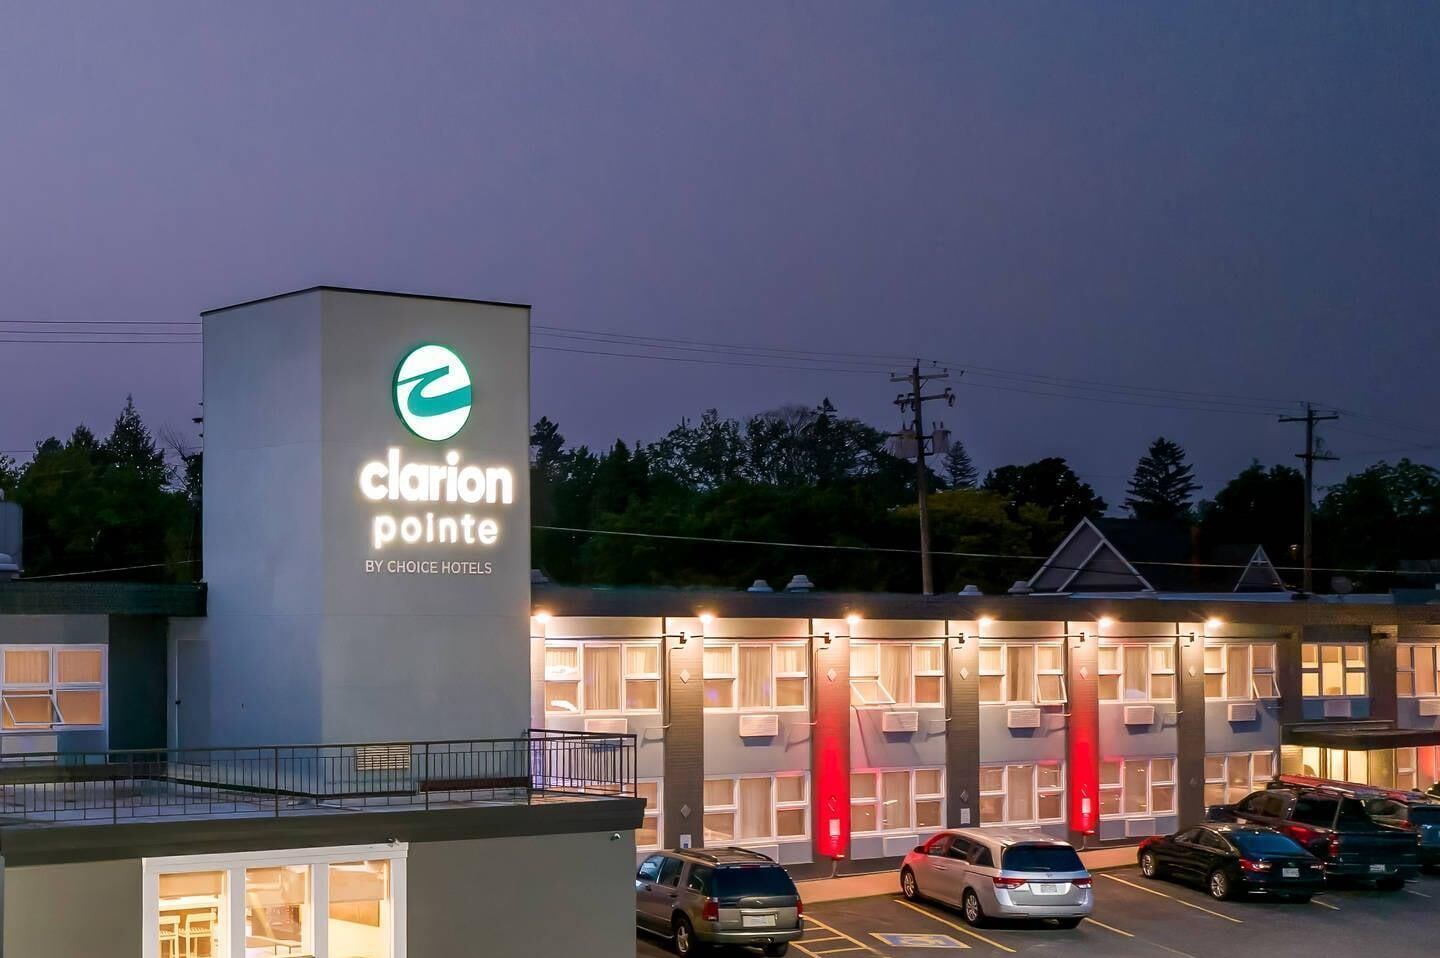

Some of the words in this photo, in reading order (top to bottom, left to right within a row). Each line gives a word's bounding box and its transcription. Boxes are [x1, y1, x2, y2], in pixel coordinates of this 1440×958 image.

[360, 447, 513, 504] clarion
[374, 513, 498, 549] pointe
[365, 559, 383, 573] BY
[387, 560, 438, 574] CHOICE
[441, 561, 492, 574] HOTELS
